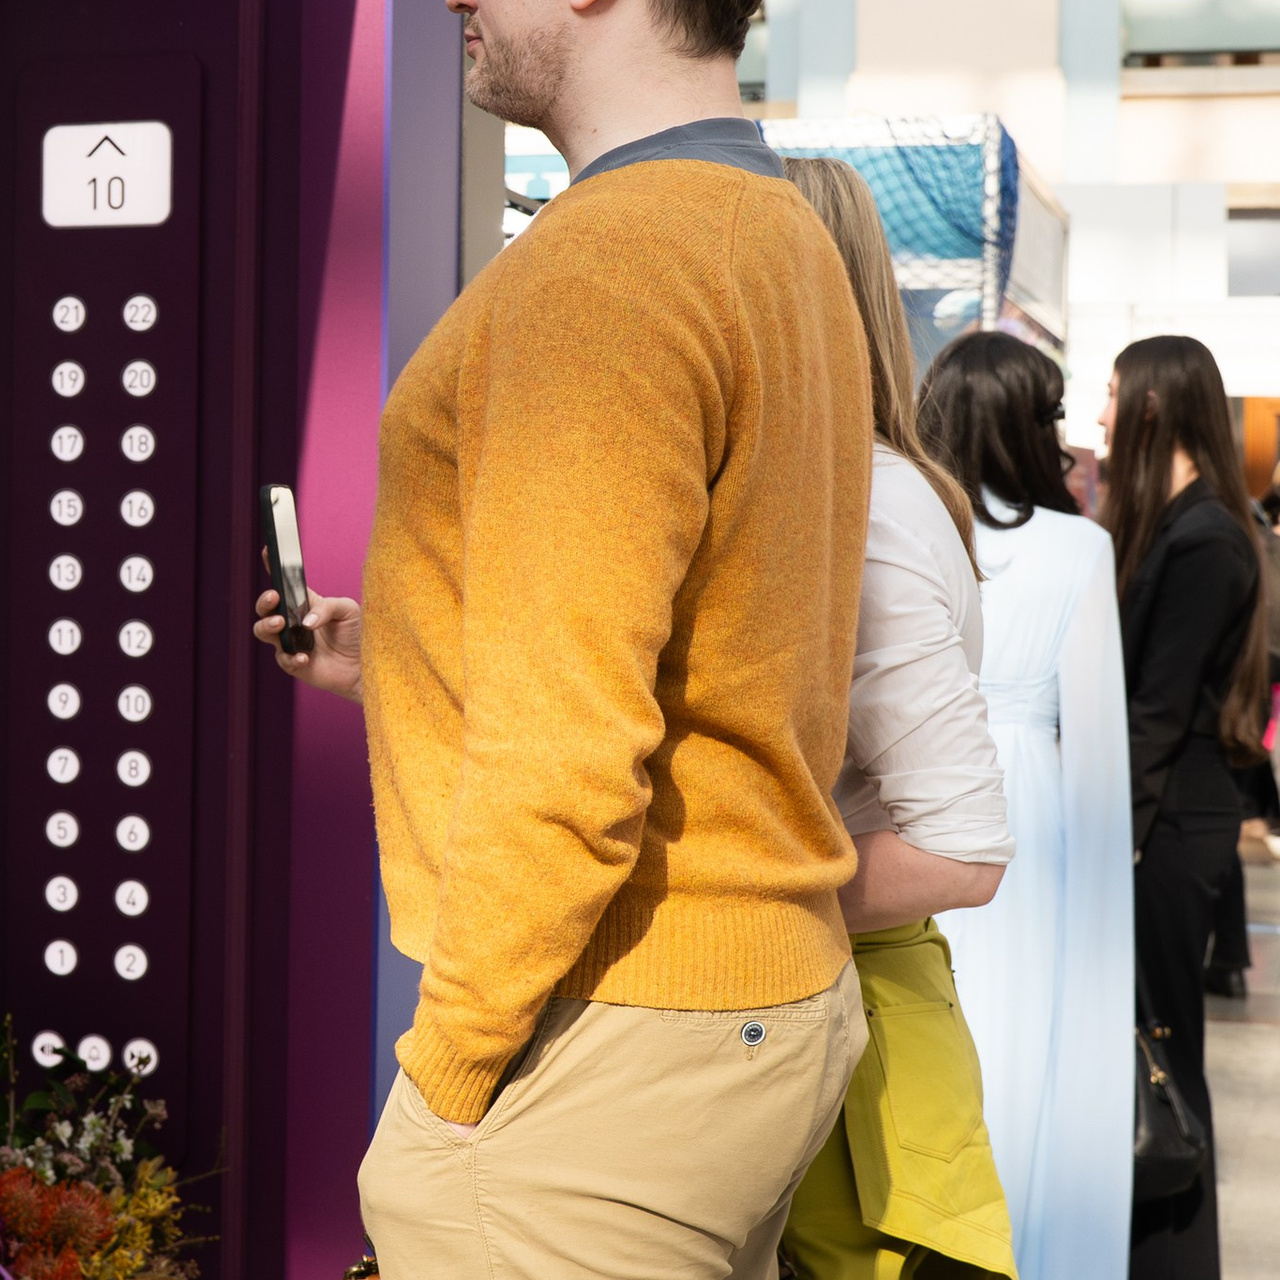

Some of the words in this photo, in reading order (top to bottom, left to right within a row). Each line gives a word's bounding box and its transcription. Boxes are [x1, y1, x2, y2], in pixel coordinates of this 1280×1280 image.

[88, 176, 125, 211] 10
[60, 305, 80, 325] 21
[129, 304, 151, 323] 22
[59, 370, 79, 388] 19
[128, 369, 150, 388] 20
[58, 435, 78, 453] 17
[128, 434, 149, 454] 18
[57, 499, 78, 518] 15
[127, 500, 148, 519] 16
[56, 563, 77, 583] 13
[127, 565, 147, 584] 14
[57, 628, 75, 647] 11
[126, 630, 147, 650] 12
[59, 692, 69, 709] 9
[125, 695, 146, 714] 10
[59, 757, 69, 774] 7
[129, 759, 139, 779] 8
[58, 821, 68, 840] 5
[128, 826, 138, 843] 6
[58, 885, 68, 904] 3
[126, 890, 137, 907] 4
[58, 949, 65, 967] 1
[126, 953, 137, 973] 2
